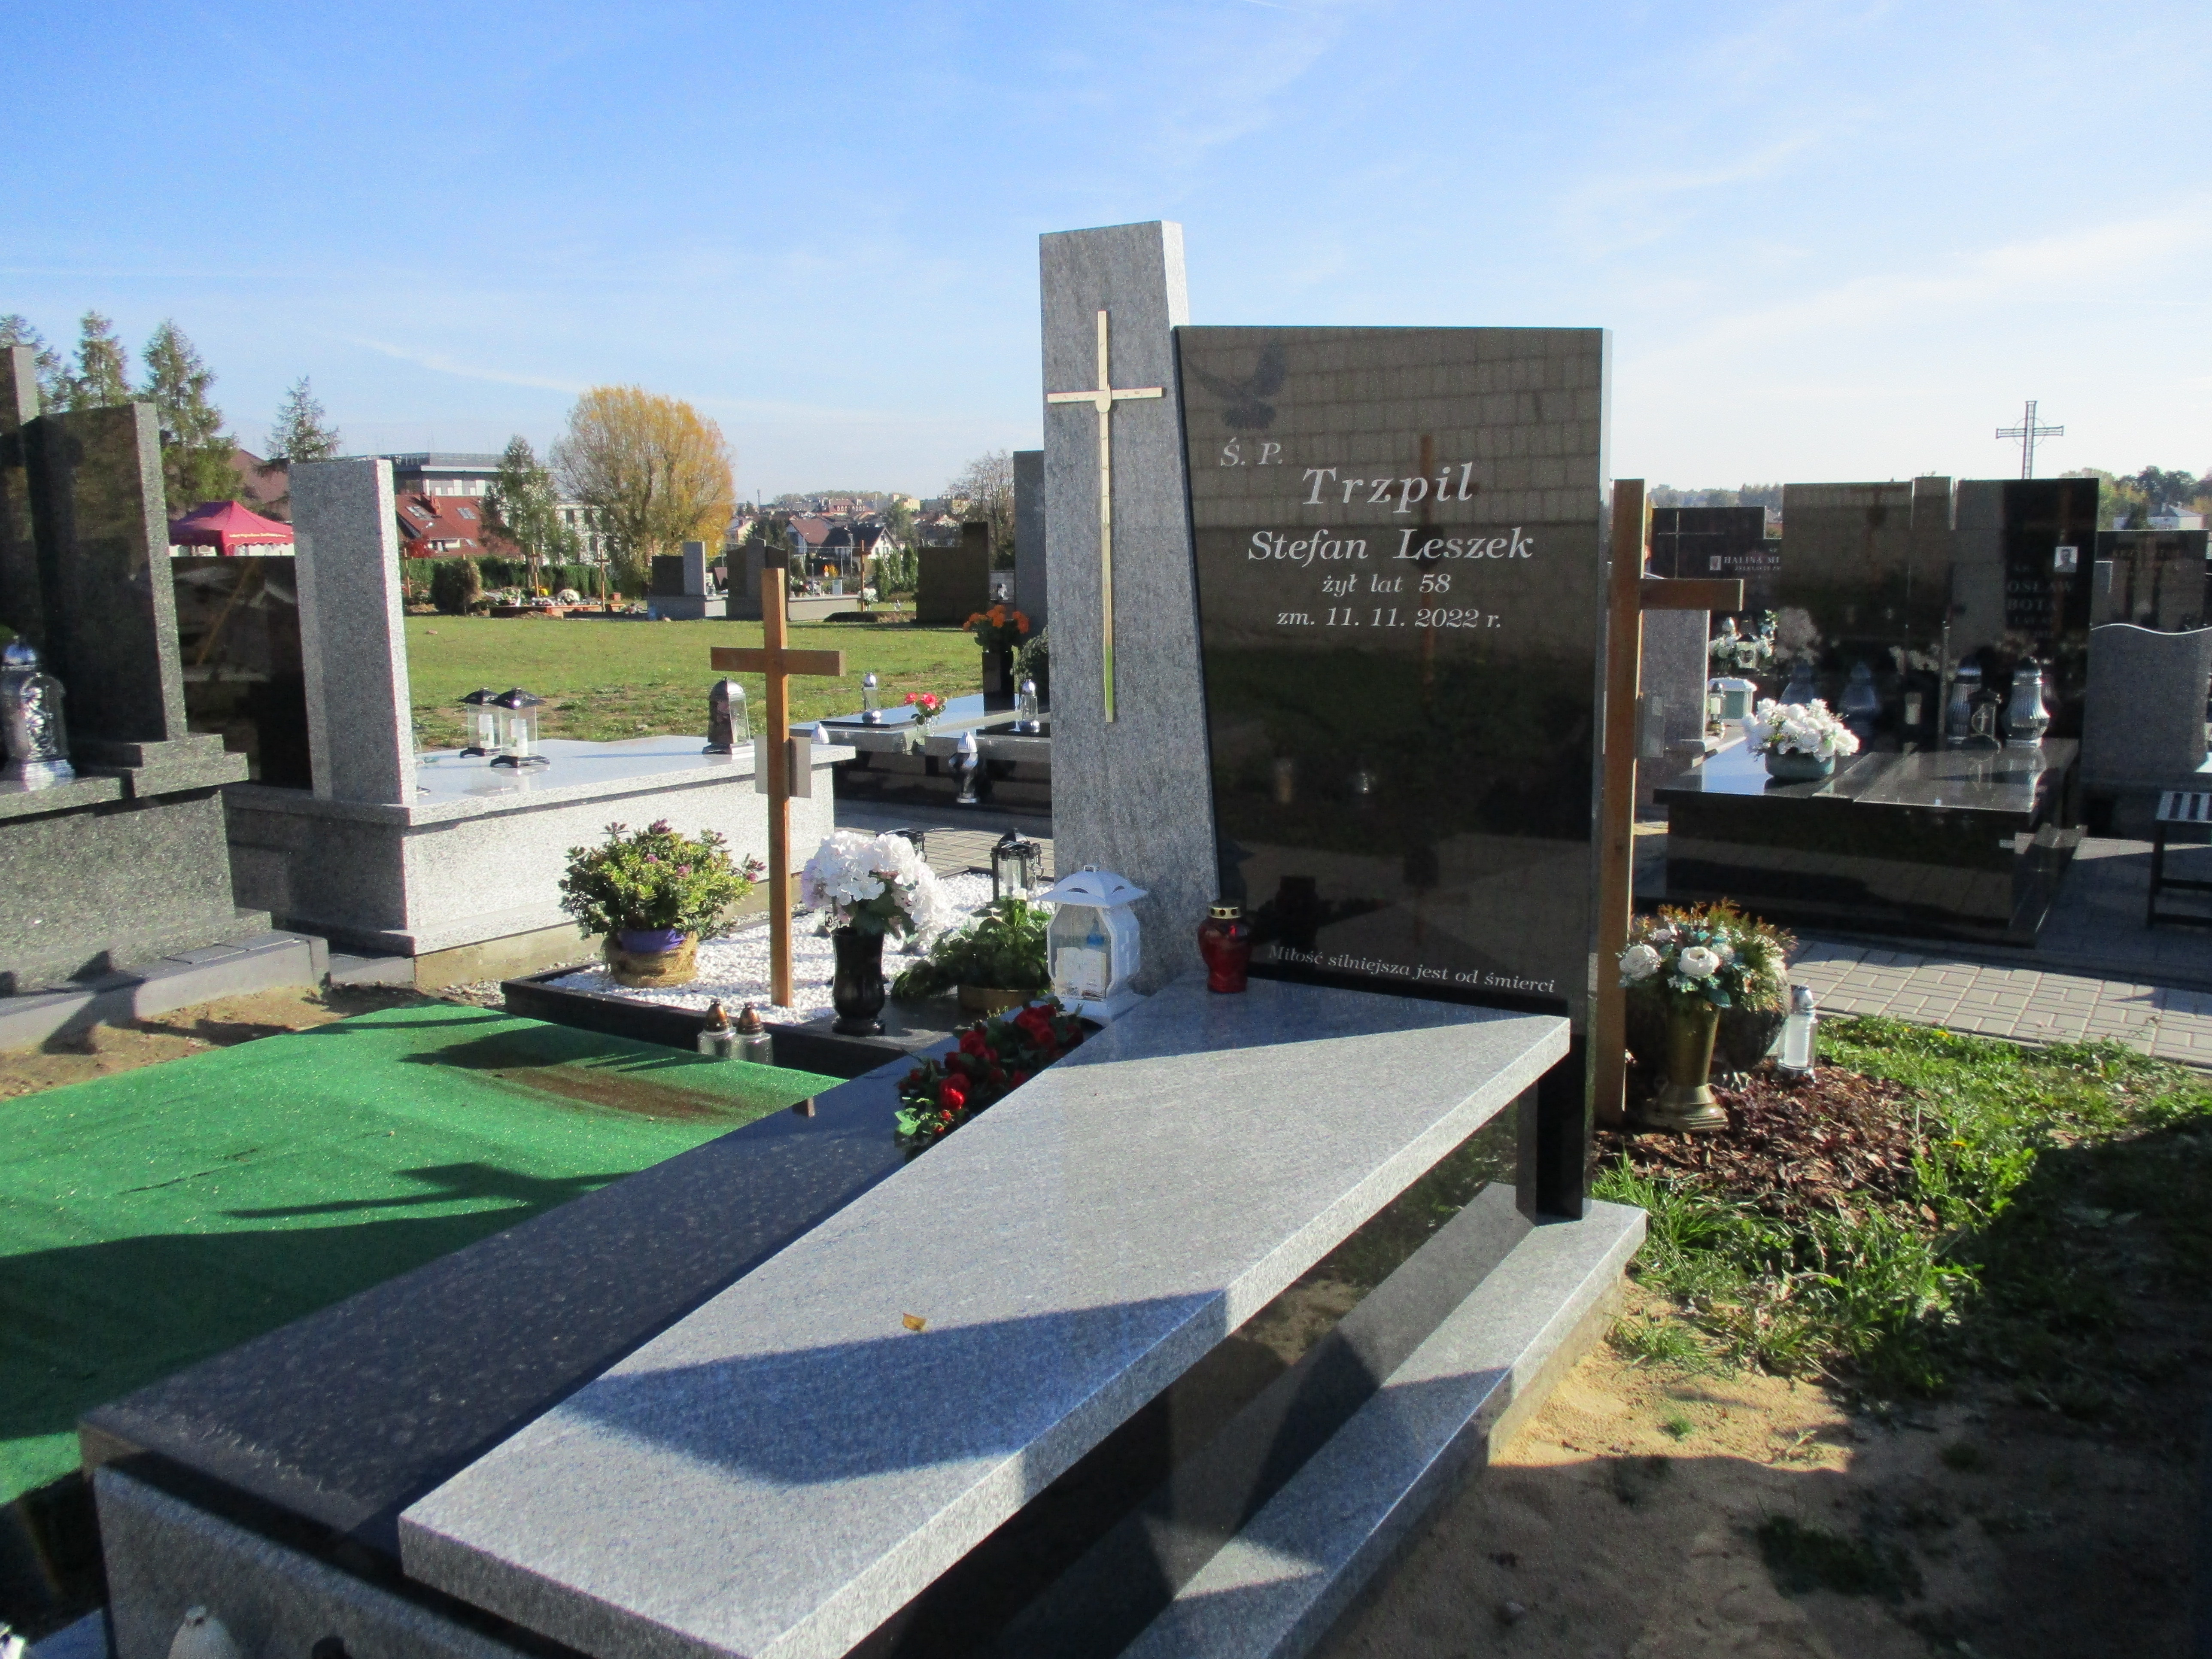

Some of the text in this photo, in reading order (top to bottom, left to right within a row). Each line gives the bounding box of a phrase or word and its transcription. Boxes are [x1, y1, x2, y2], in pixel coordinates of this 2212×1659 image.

[1220, 437, 1284, 466] Ś. P.
[1302, 462, 1473, 514] Trzpil
[1248, 527, 1534, 567] Stefan Leszek
[1322, 574, 1451, 597] żył lat 58
[1276, 608, 1501, 628] zm. 11. 11. 2022 r.
[1268, 945, 1556, 993] Miłość silniejsza jest od śmierci
